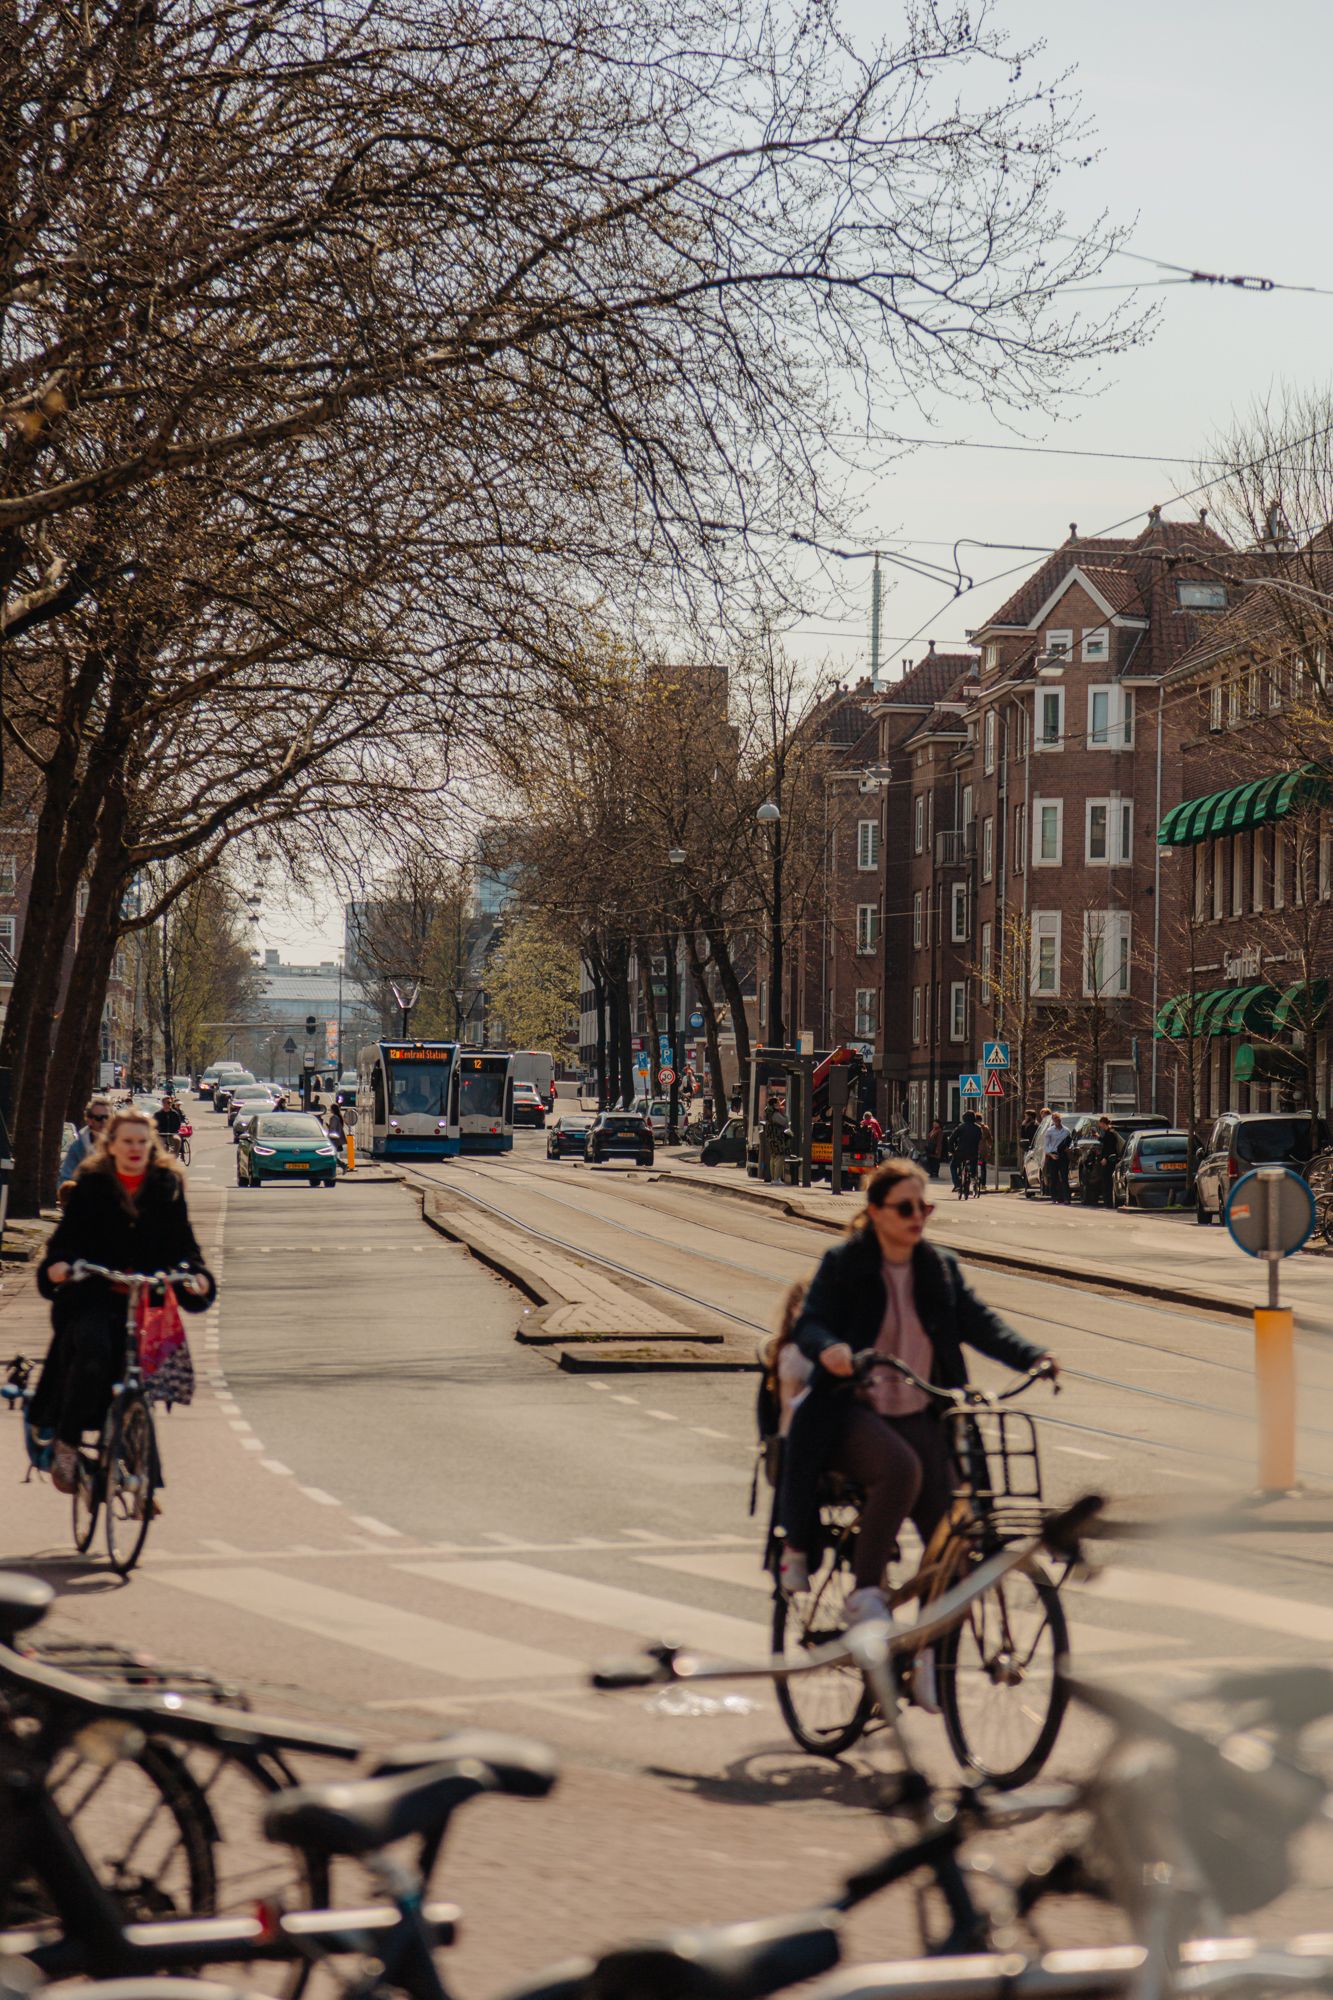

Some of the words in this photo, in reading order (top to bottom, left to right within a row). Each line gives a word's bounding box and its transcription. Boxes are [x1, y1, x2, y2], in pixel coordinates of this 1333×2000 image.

[402, 1049, 425, 1059] Centraal
[426, 1049, 448, 1059] Station
[474, 1059, 482, 1069] 12
[662, 1073, 672, 1081] 30
